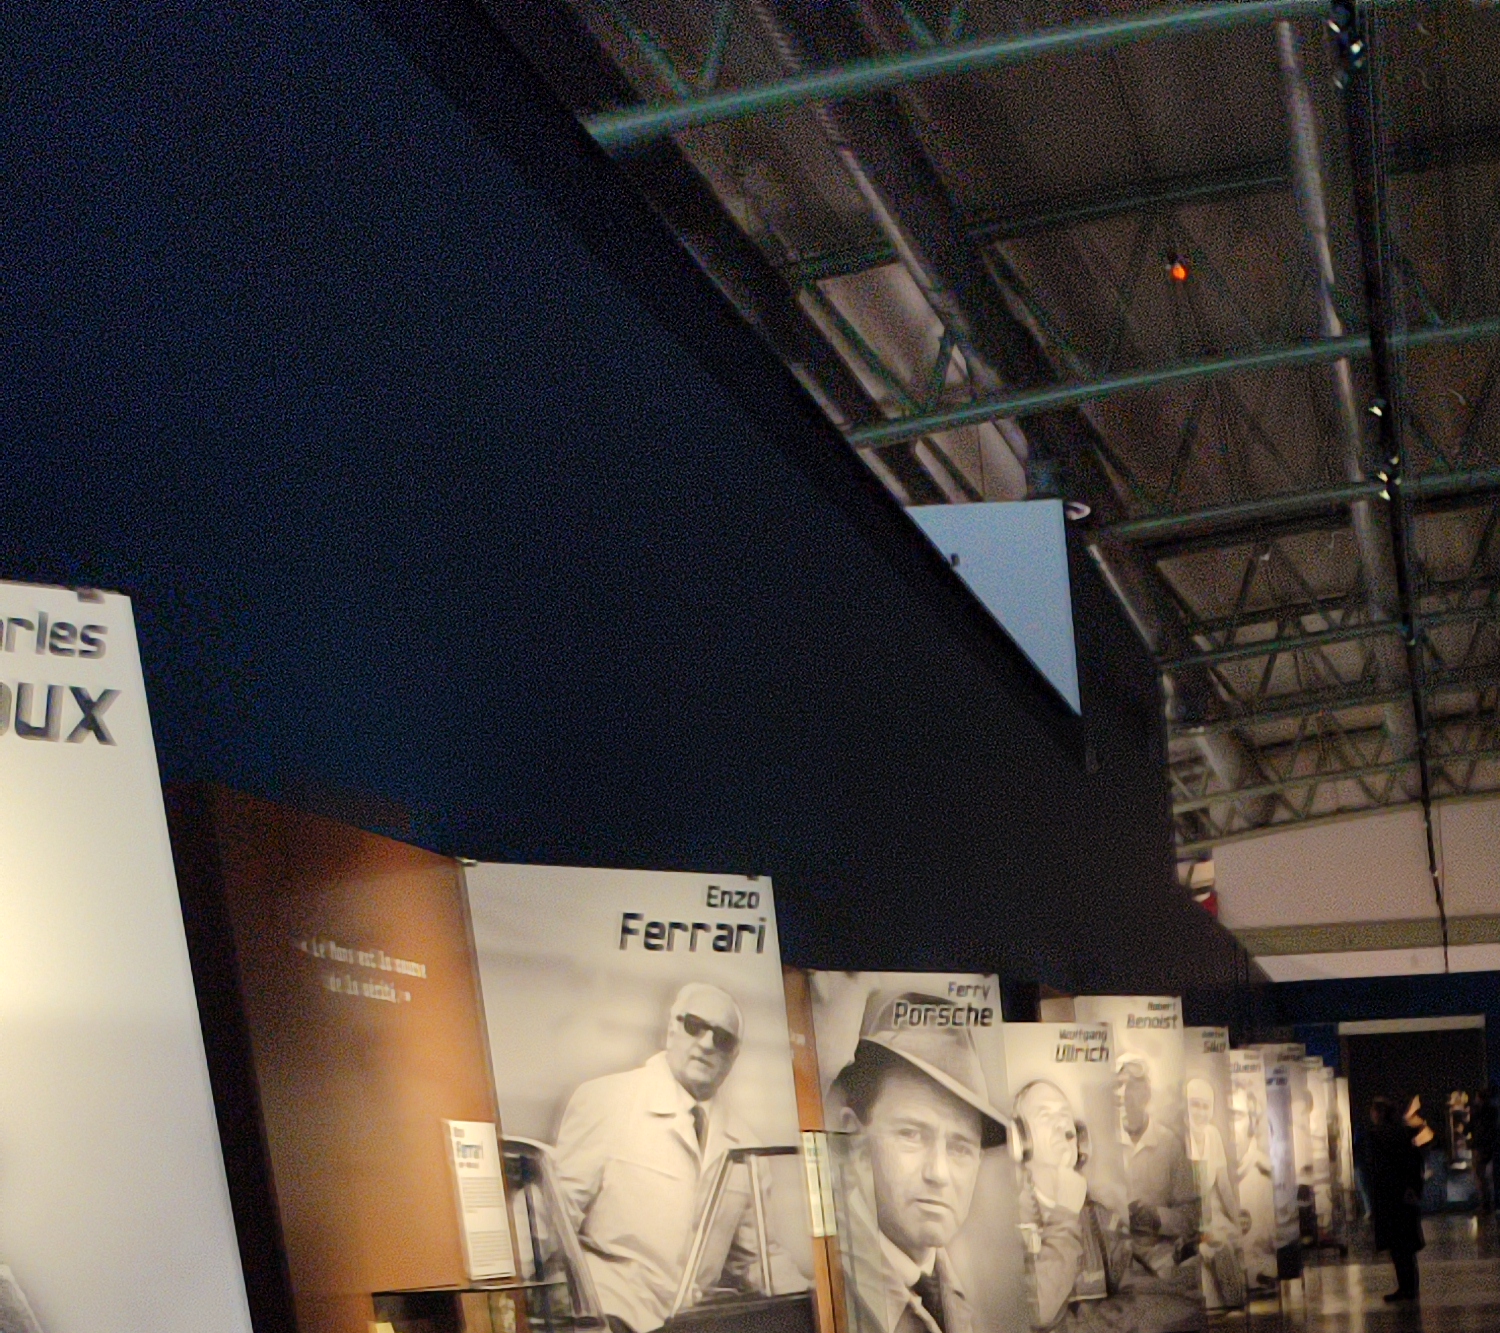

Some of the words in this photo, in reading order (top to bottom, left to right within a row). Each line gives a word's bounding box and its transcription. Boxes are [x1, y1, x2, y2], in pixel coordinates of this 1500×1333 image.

[0, 611, 108, 660] rles
[0, 681, 122, 746] ux
[706, 885, 760, 909] Enzo
[619, 912, 767, 954] Ferrari
[948, 981, 991, 1000] Ferry
[893, 1001, 993, 1027] Porsche
[1126, 1013, 1178, 1029] Benoist
[1055, 1043, 1110, 1063] Ullrich
